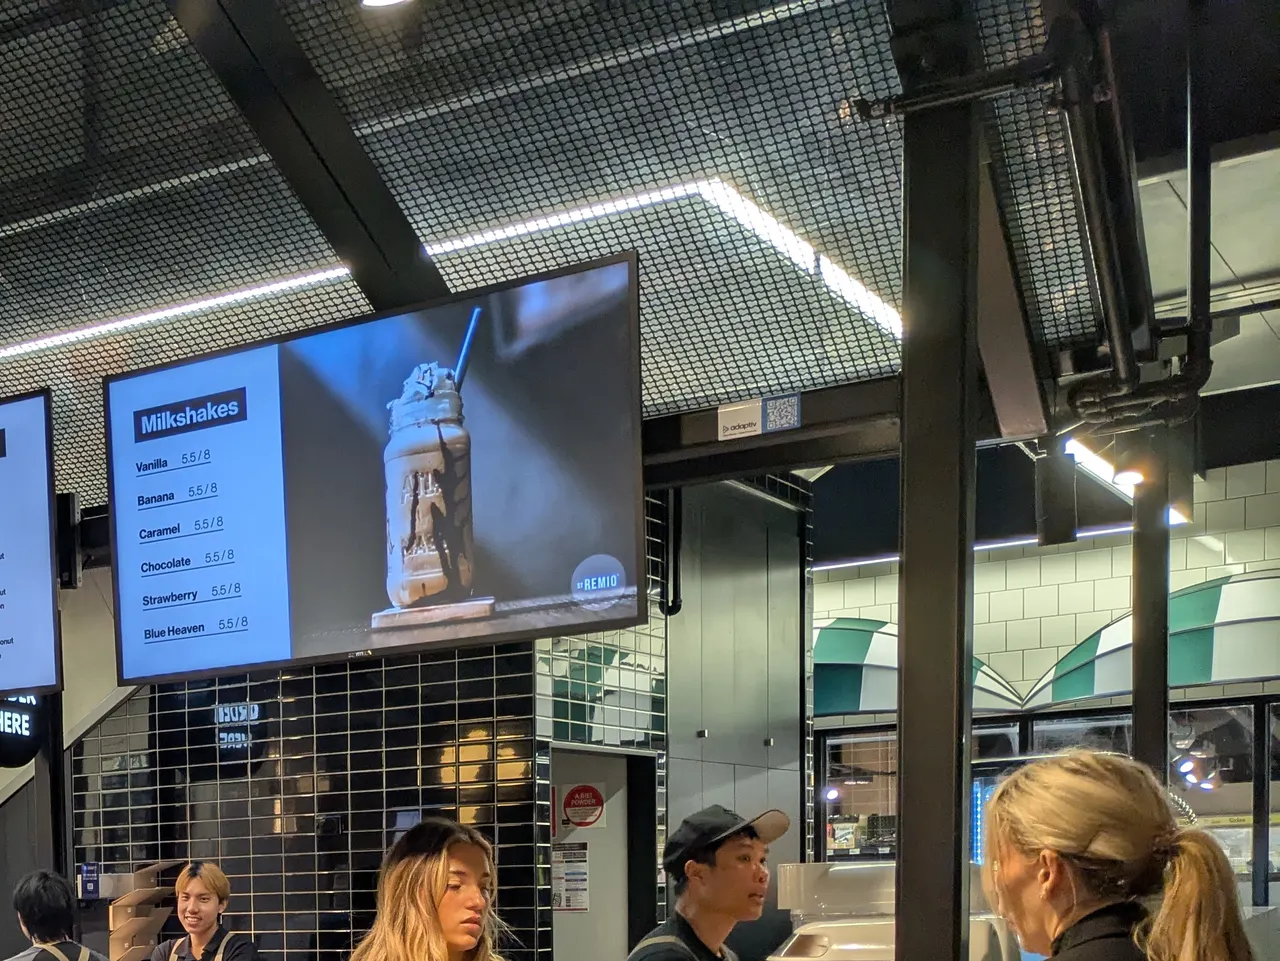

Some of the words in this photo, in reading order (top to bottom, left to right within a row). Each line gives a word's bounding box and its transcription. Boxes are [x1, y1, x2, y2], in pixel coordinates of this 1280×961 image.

[141, 401, 239, 434] Milkshakes
[730, 422, 757, 431] adaptiv
[136, 458, 168, 472] Vanilla
[137, 492, 175, 506] Banana
[139, 523, 180, 539] Caramel
[141, 557, 191, 573] Chocolate
[584, 574, 617, 591] REMIO
[142, 590, 198, 606] Strawberry
[144, 628, 166, 639] Blue
[167, 624, 205, 637] Heaven
